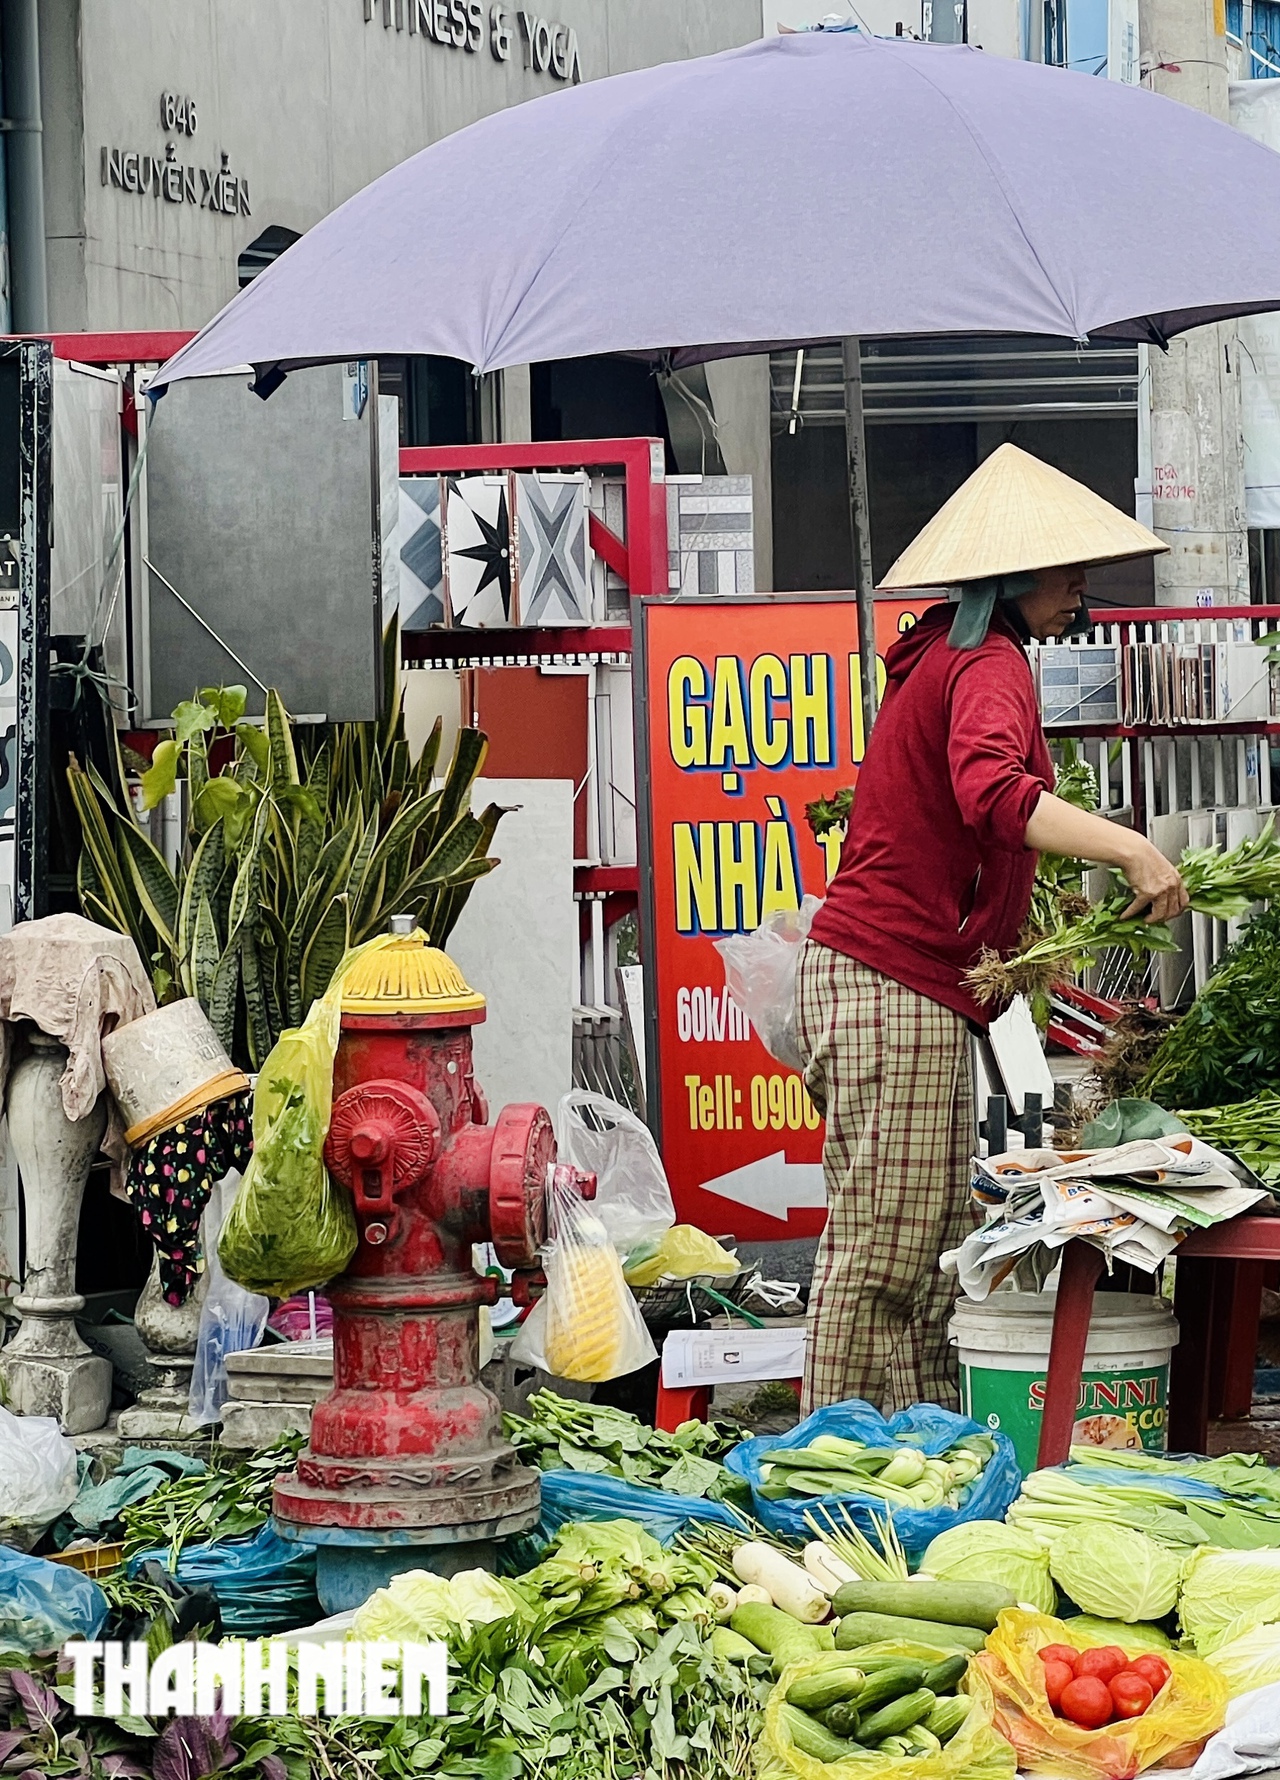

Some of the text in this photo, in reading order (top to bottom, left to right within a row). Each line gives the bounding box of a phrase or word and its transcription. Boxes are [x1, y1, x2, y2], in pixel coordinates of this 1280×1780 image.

[490, 5, 513, 62] &
[517, 11, 583, 84] YOGA
[160, 88, 197, 137] 646
[668, 653, 832, 793] GẠCH
[672, 796, 801, 932] NHÀ
[685, 1074, 742, 1130] Tell:
[1125, 1408, 1165, 1431] ECO
